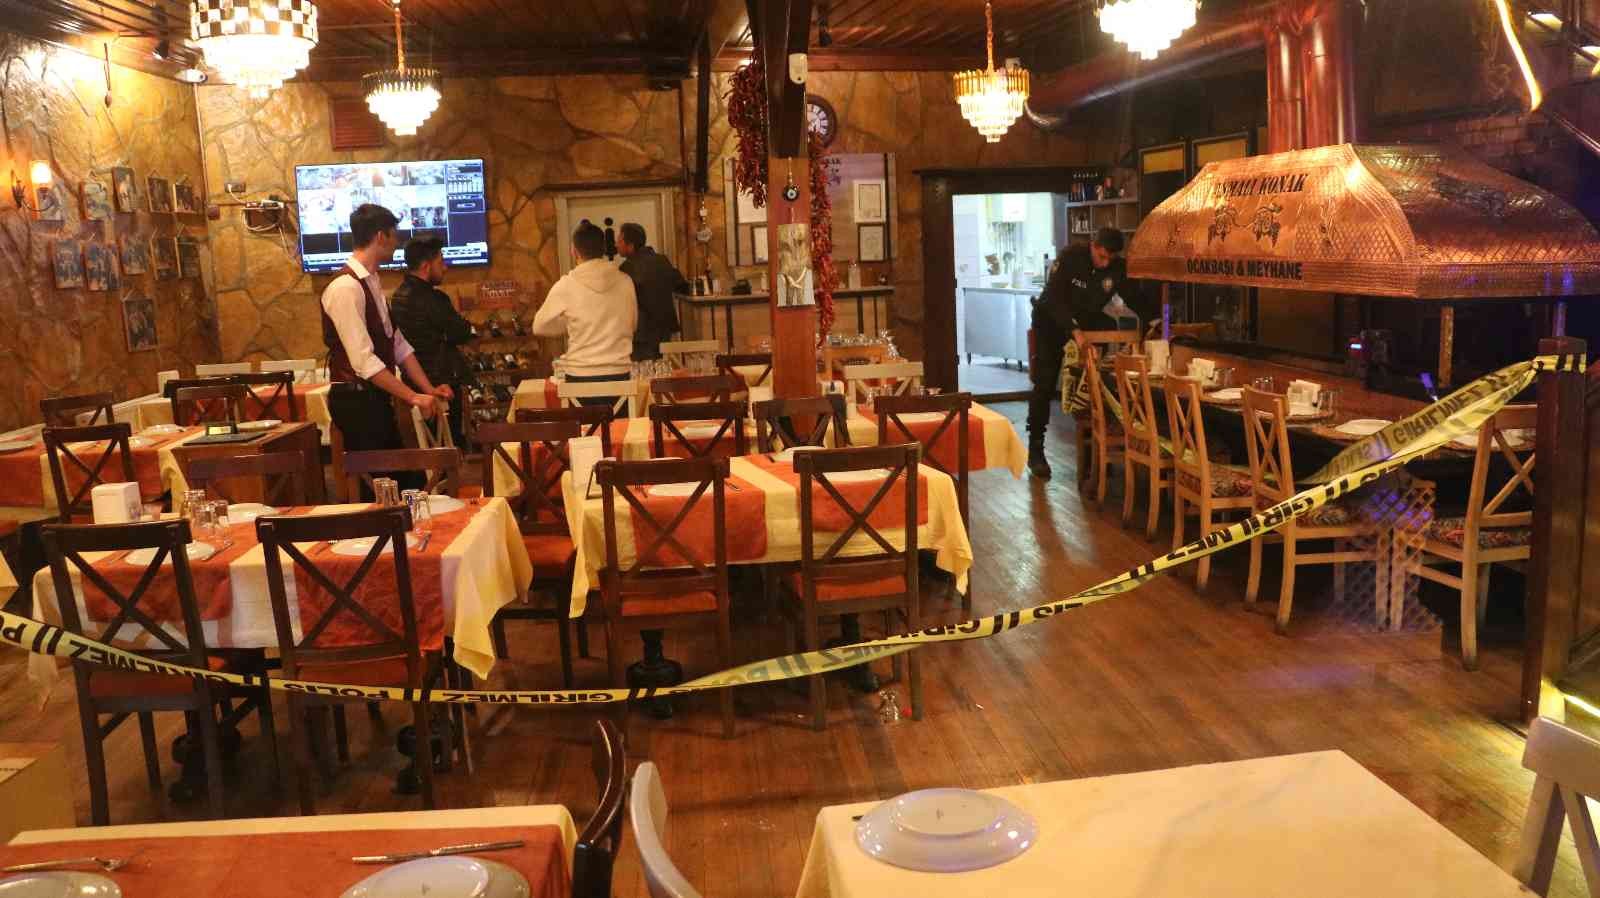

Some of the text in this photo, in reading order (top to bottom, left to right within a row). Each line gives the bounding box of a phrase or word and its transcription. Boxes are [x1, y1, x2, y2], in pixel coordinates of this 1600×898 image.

[1258, 173, 1308, 195] KONAK
[1236, 259, 1245, 276] &
[1247, 260, 1302, 280] MEYHANE
